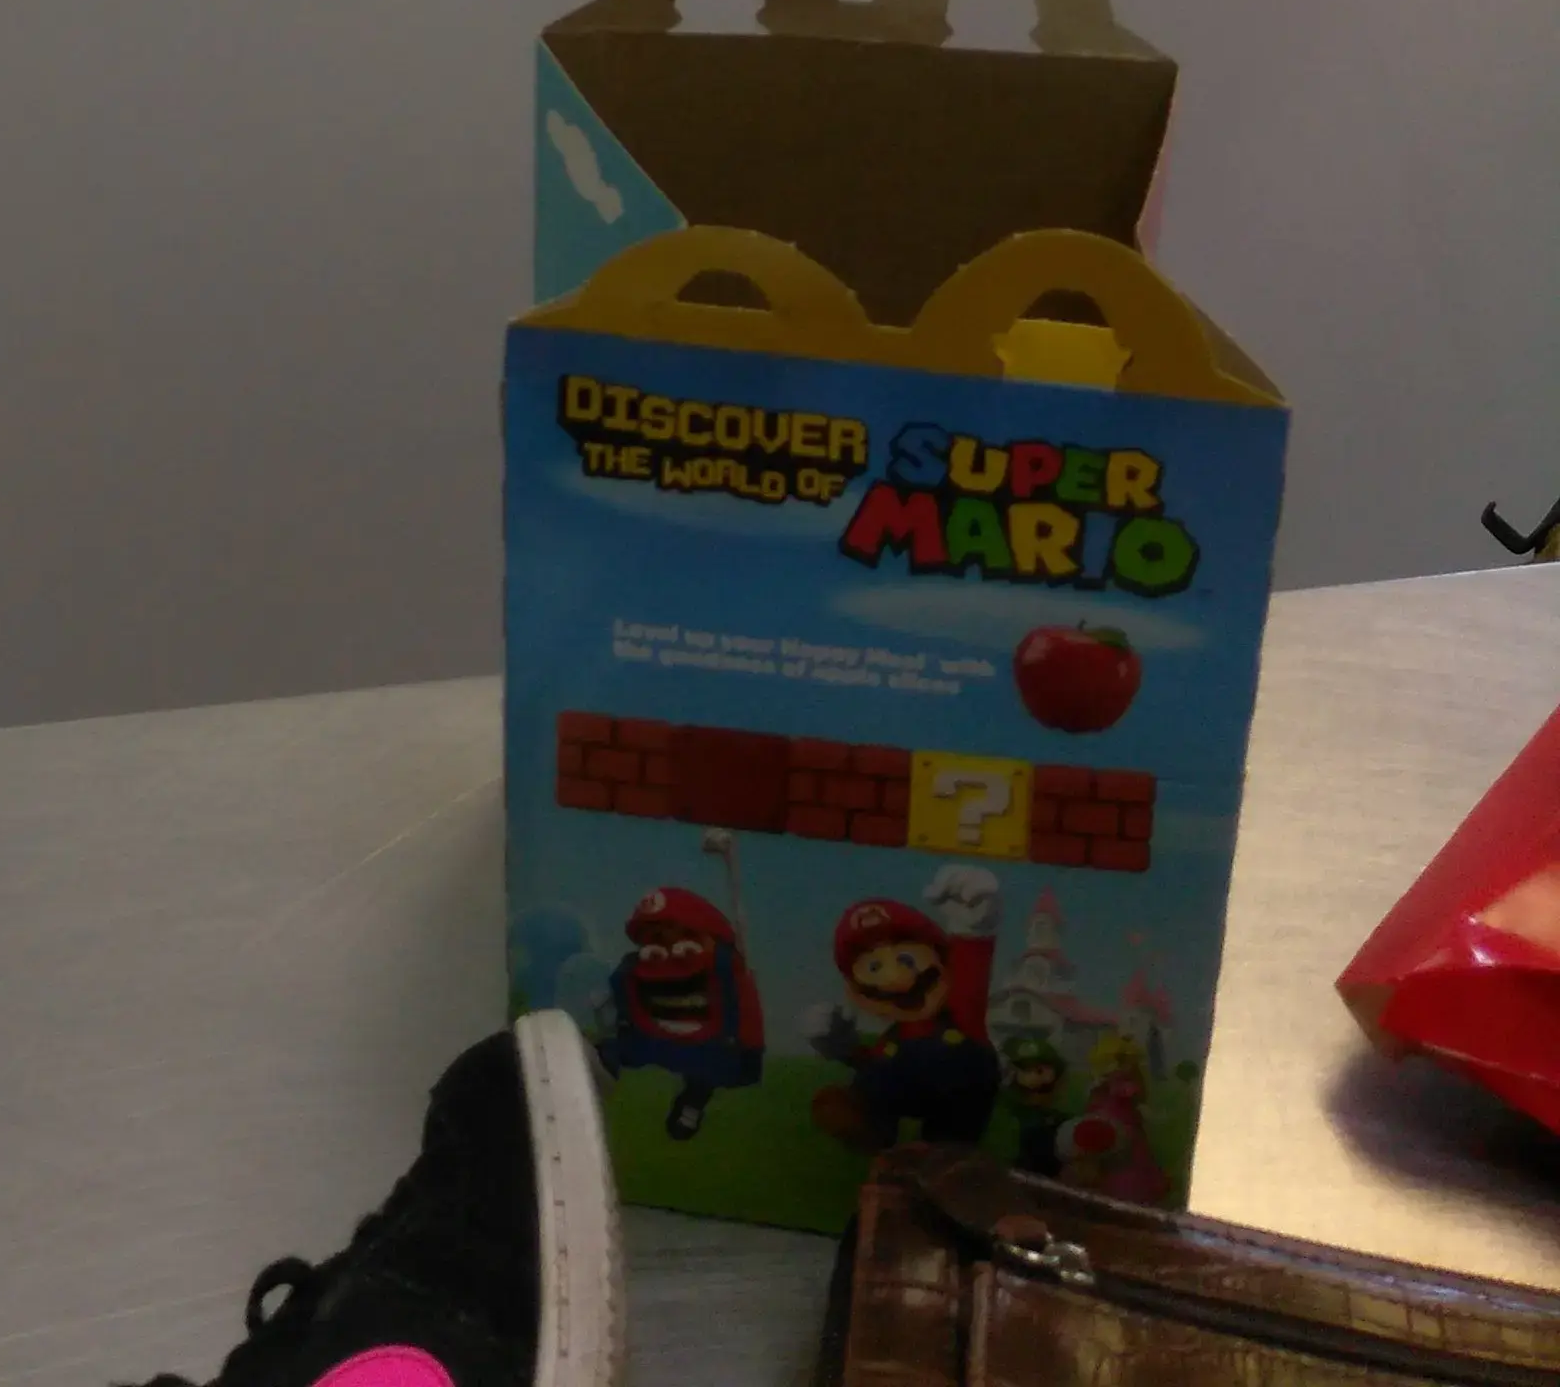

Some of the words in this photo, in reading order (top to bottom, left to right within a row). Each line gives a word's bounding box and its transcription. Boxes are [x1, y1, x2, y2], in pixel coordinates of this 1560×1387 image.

[561, 375, 868, 465] DISCOVER
[583, 440, 652, 476] THE
[662, 455, 787, 503] WORLD
[796, 468, 847, 501] OF
[887, 421, 1164, 510] SUPER
[839, 481, 1201, 598] MARIO
